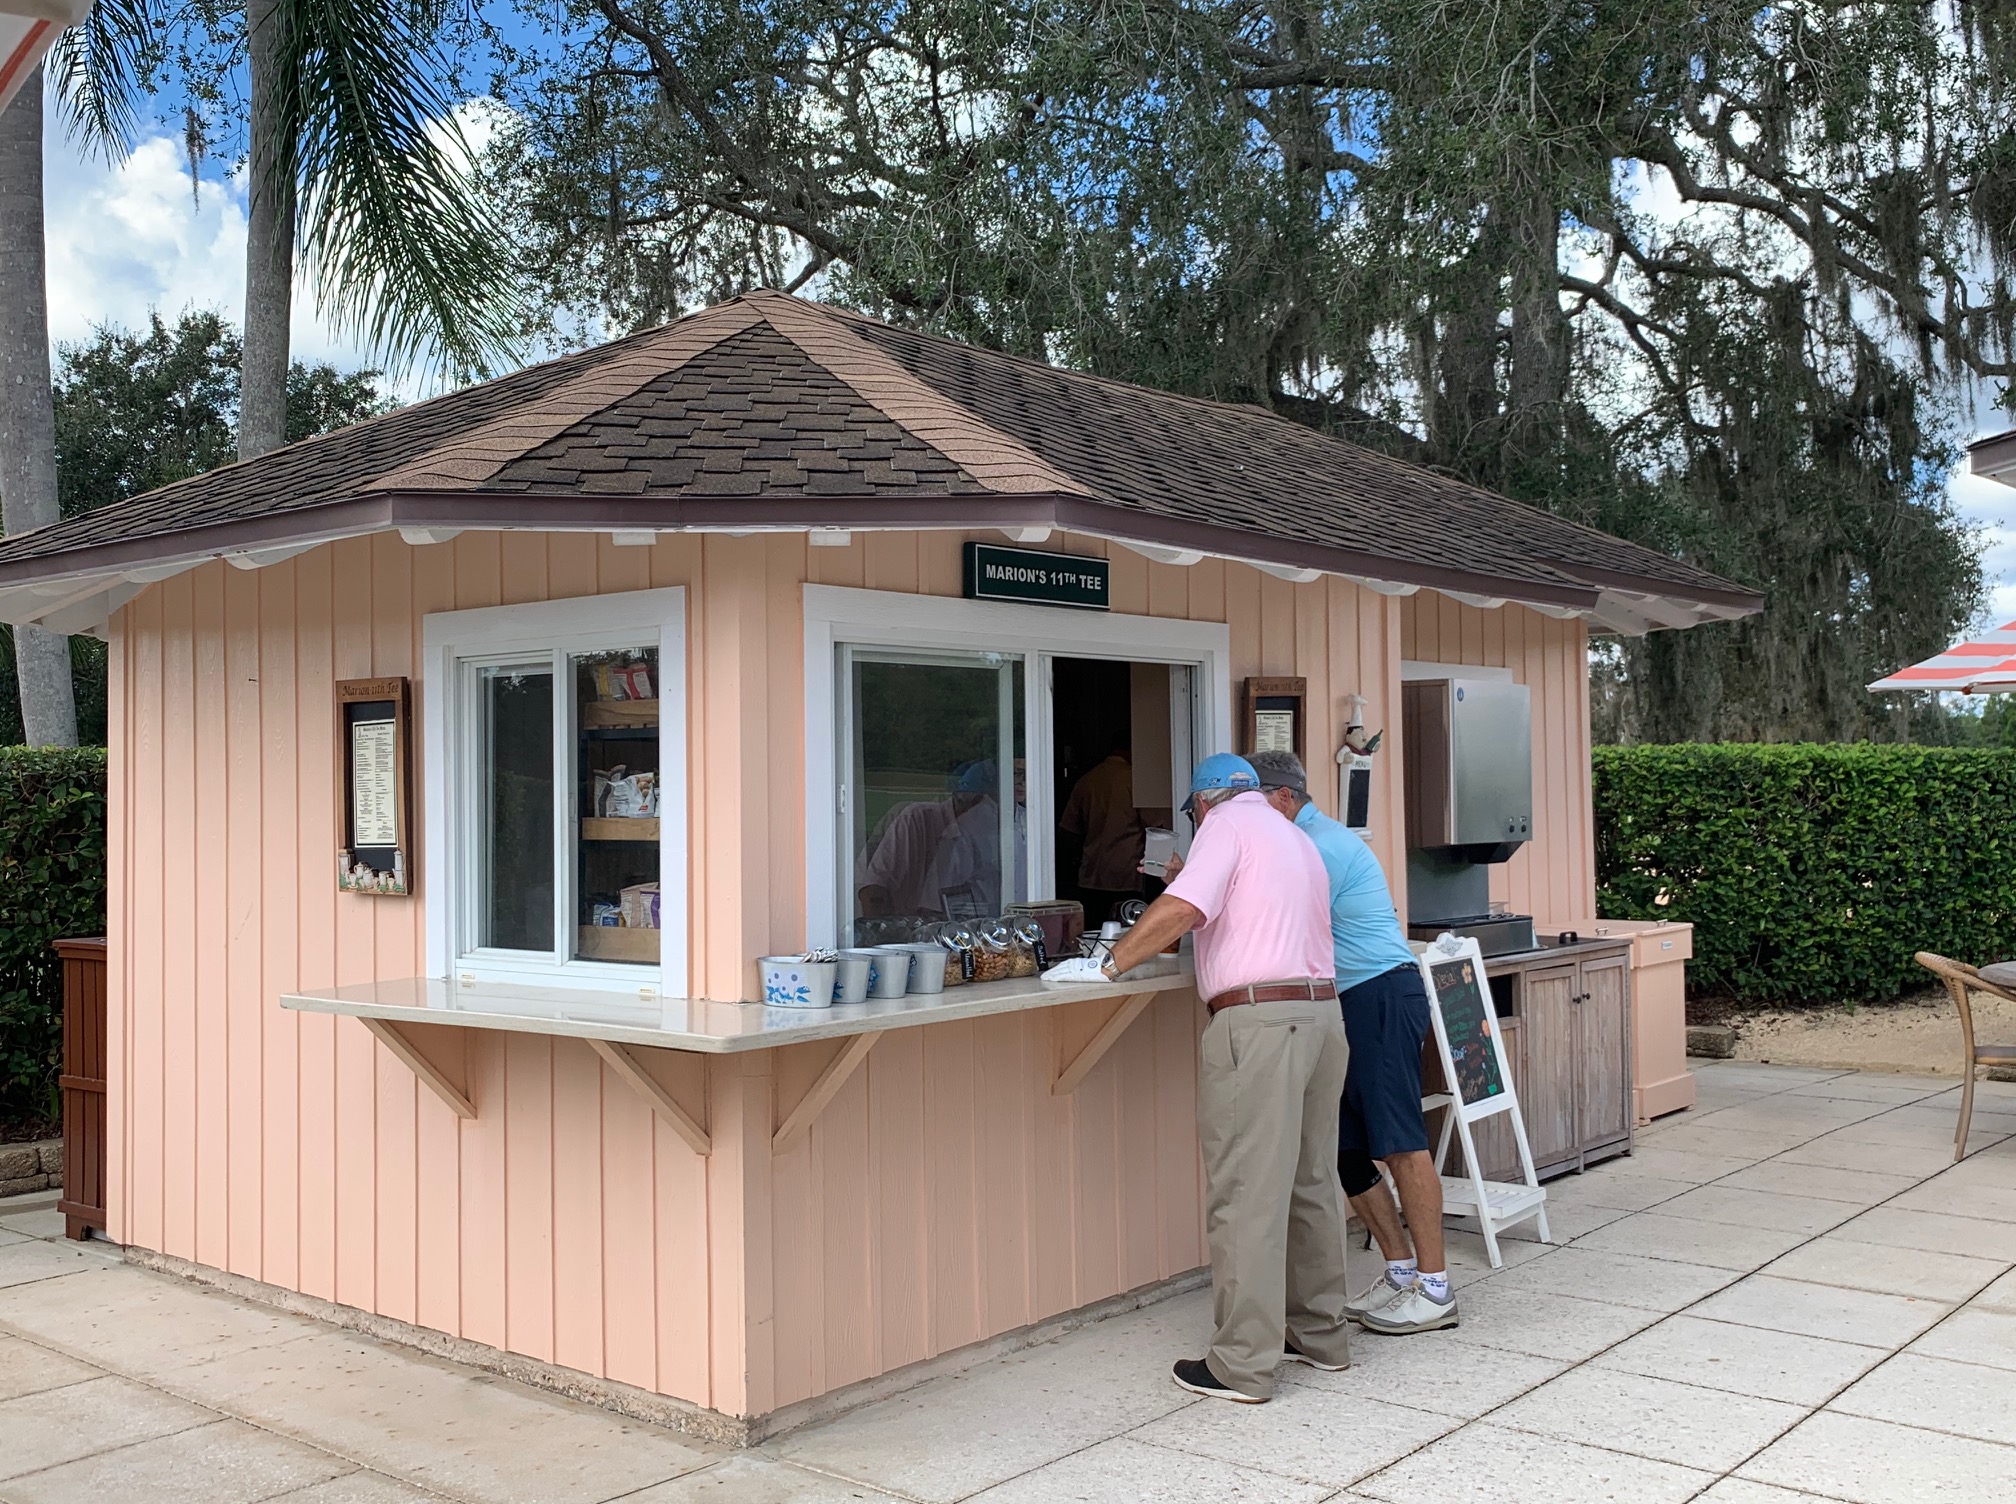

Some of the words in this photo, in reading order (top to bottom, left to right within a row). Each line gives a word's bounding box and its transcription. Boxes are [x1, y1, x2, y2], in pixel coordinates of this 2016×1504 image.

[986, 564, 1047, 584] MARION'S
[1050, 572, 1076, 586] 11TH
[1079, 575, 1101, 590] TEE
[387, 681, 399, 694] Tee
